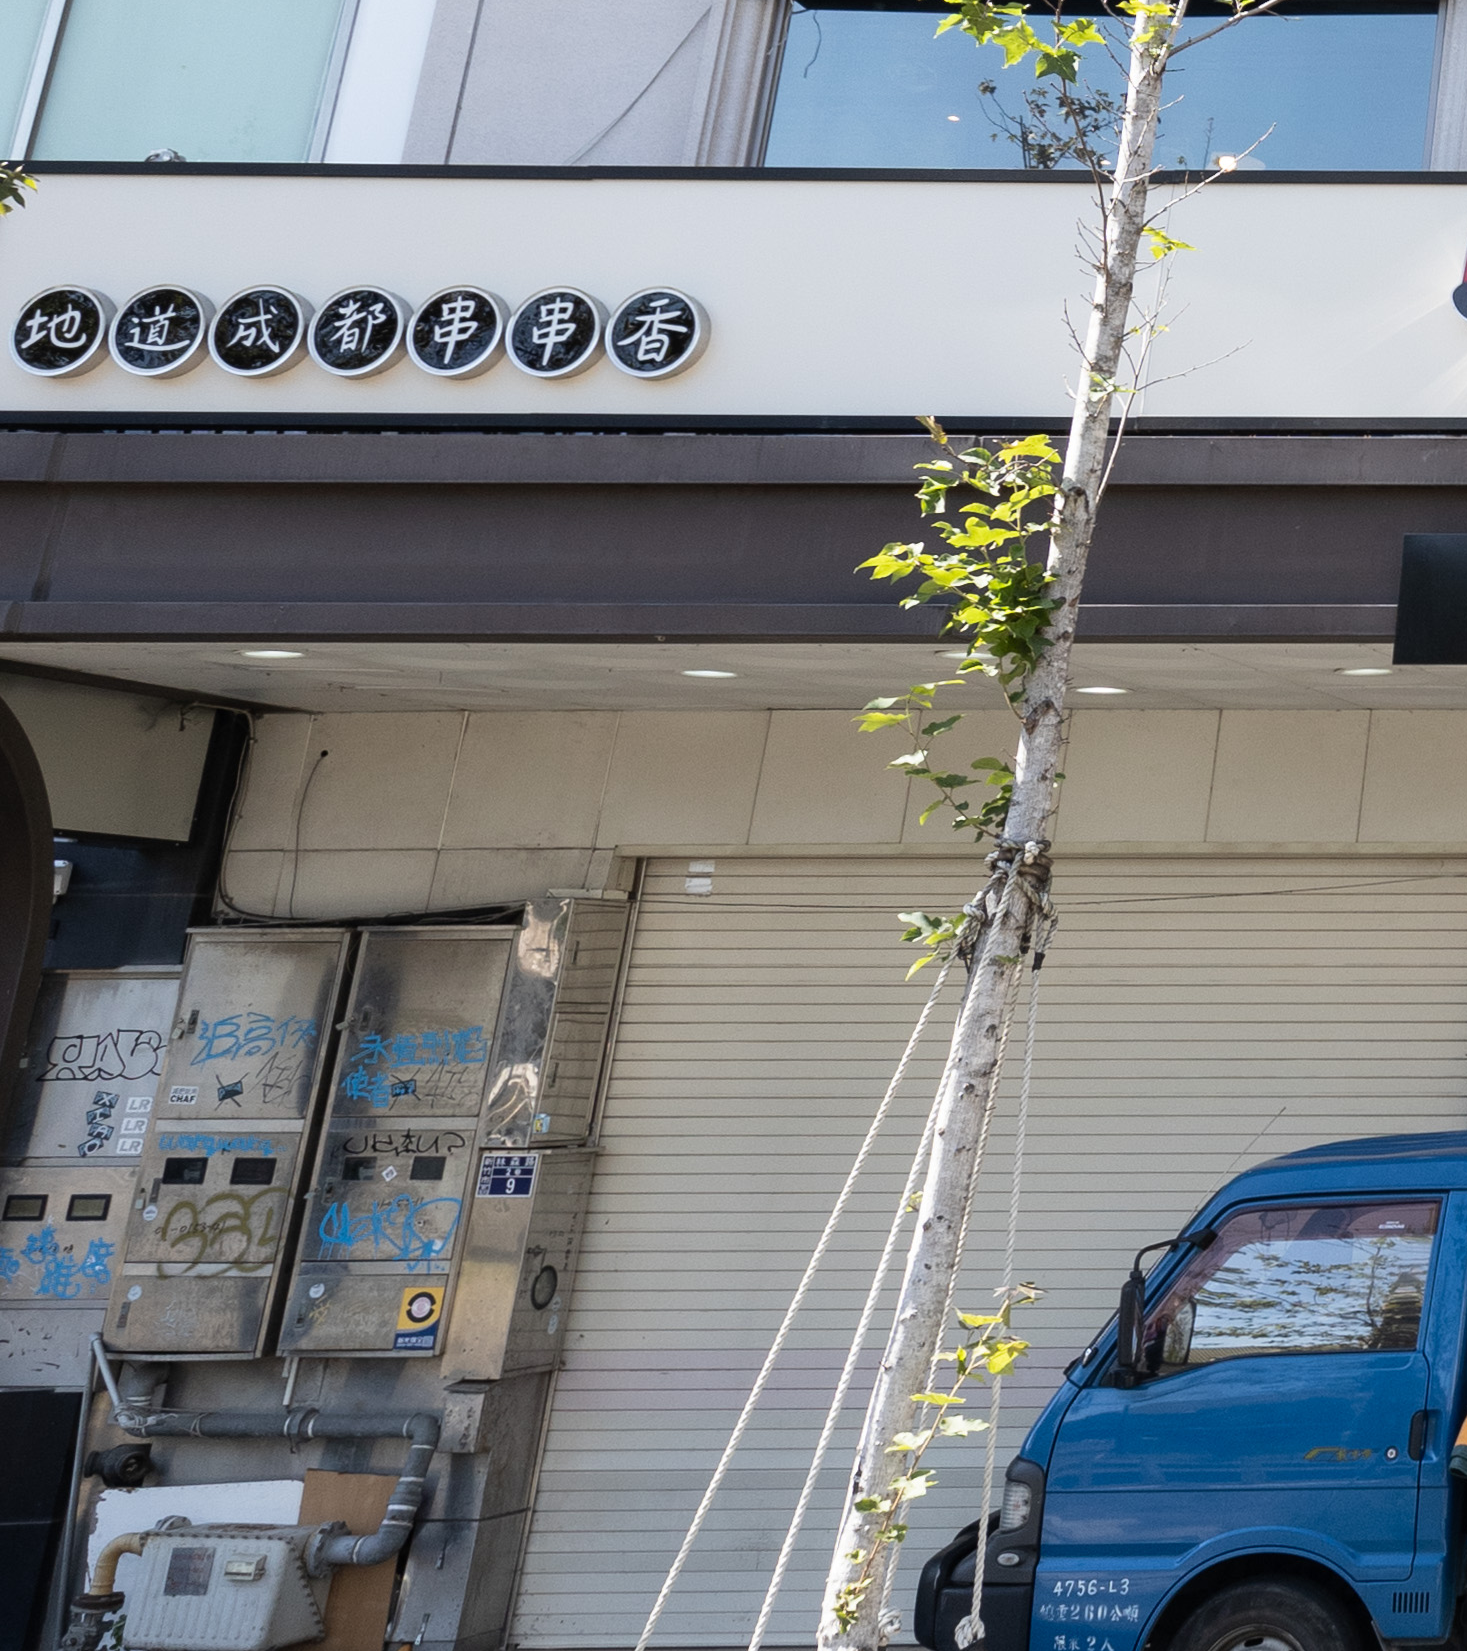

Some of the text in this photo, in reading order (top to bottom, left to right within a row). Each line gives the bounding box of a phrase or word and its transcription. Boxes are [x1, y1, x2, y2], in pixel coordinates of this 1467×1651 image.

[16, 292, 695, 370] 地道成都串串香
[505, 1178, 516, 1194] 9
[1053, 1578, 1130, 1597] 4756-L3
